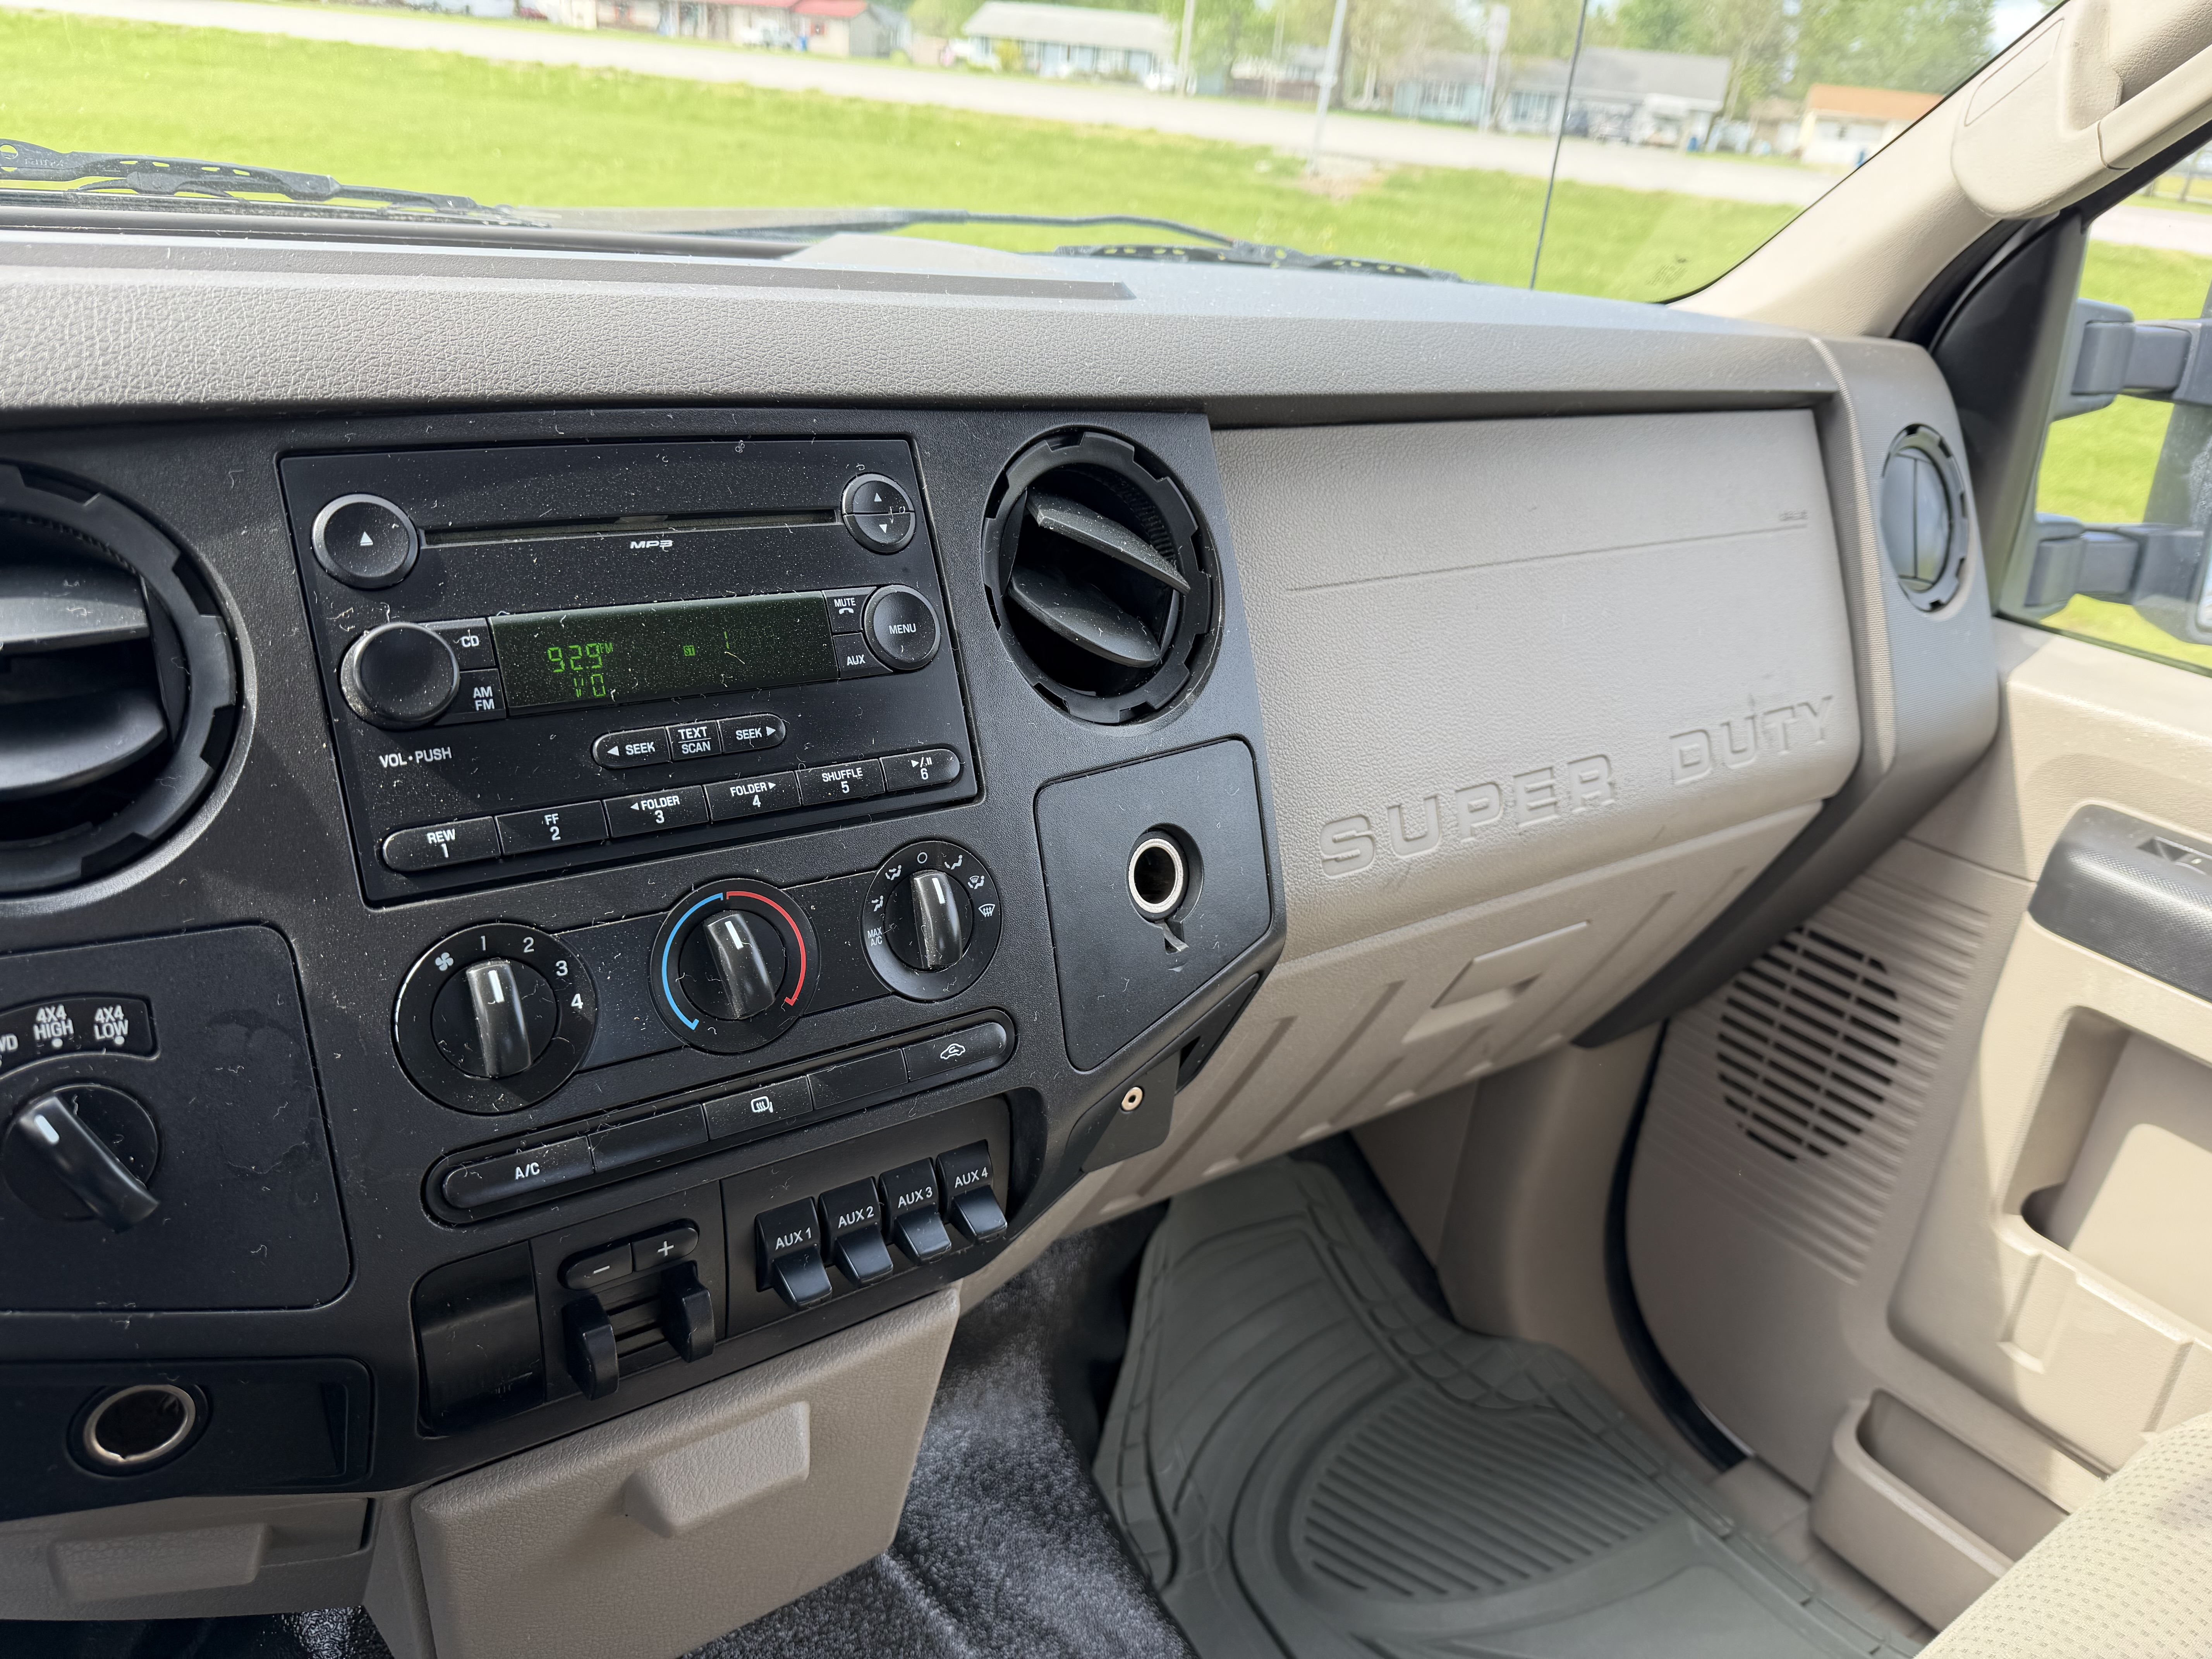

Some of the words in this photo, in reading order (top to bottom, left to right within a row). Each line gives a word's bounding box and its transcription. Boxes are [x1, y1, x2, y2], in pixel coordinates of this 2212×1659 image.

[630, 539, 673, 550] MP3
[834, 597, 856, 608] MUTE
[889, 623, 916, 635] MENU
[462, 635, 479, 647] CD
[847, 654, 866, 666] AUX
[473, 687, 493, 698] AM
[475, 699, 495, 710] FM
[677, 726, 707, 739] TEXT
[735, 727, 762, 741] SEEK
[625, 742, 655, 756] SEEK
[681, 741, 711, 754] SCAN
[379, 753, 407, 768] VOL
[415, 747, 452, 763] PUSH
[821, 767, 863, 783] SHUFFLE
[920, 768, 928, 780] 6
[730, 781, 766, 796] FOLDER
[841, 781, 849, 793] 5
[1319, 754, 1616, 880] SUPER
[1668, 696, 1833, 785] DUTY
[640, 795, 680, 808] FOLDER
[752, 795, 761, 808] 4
[544, 813, 558, 825] FF
[655, 810, 665, 824] 3
[427, 829, 455, 843] REW
[550, 826, 561, 841] 2
[441, 843, 450, 859] 1
[867, 926, 883, 938] MAX
[481, 936, 486, 951] 1
[523, 937, 534, 953] 2
[871, 938, 883, 946] A/C
[555, 960, 568, 976] 3
[570, 993, 583, 1009] 4
[36, 1004, 67, 1023] 4X4
[94, 1005, 124, 1023] 4X4
[33, 1018, 74, 1041] HIGH
[94, 1019, 129, 1040] LOW
[515, 1163, 540, 1180] A/C
[955, 1170, 979, 1188] AUX
[981, 1166, 988, 1178] 4
[898, 1190, 924, 1208] AUX
[926, 1186, 933, 1198] 3
[838, 1209, 865, 1229] AUX
[867, 1206, 874, 1218] 2
[775, 1229, 803, 1250] AUX
[805, 1226, 812, 1239] 1
